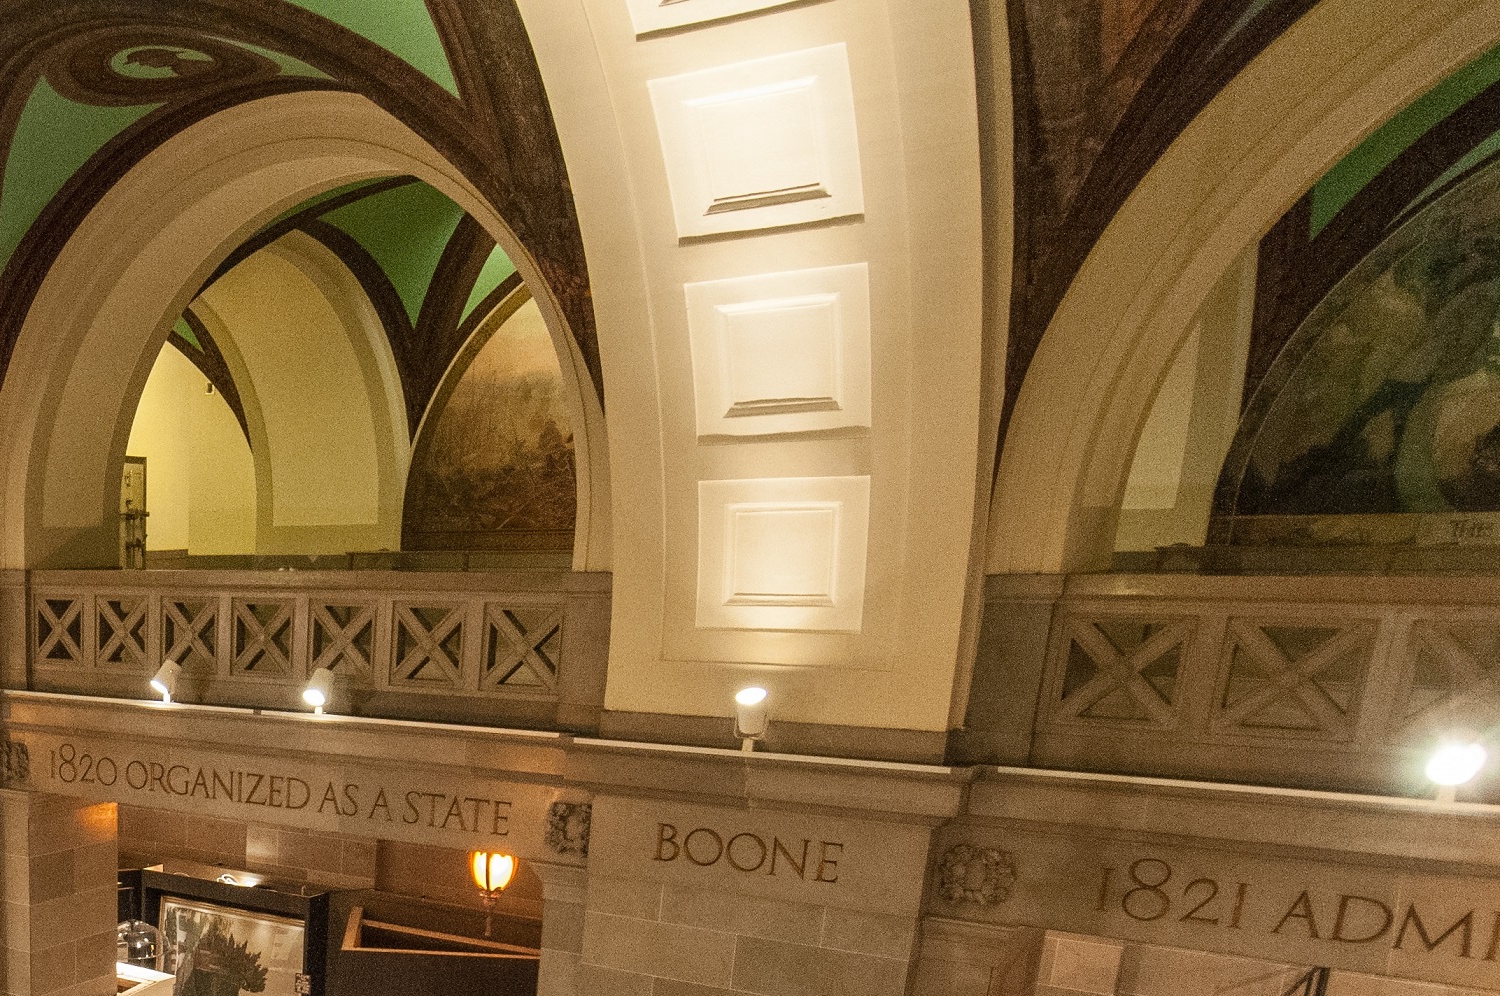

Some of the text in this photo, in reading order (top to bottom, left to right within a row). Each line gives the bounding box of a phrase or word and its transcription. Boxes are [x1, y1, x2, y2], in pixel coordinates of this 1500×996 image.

[49, 743, 512, 836] 1820 ORGANIZED AS A STATE
[654, 822, 844, 883] BOONE
[1095, 858, 1252, 929] 1821
